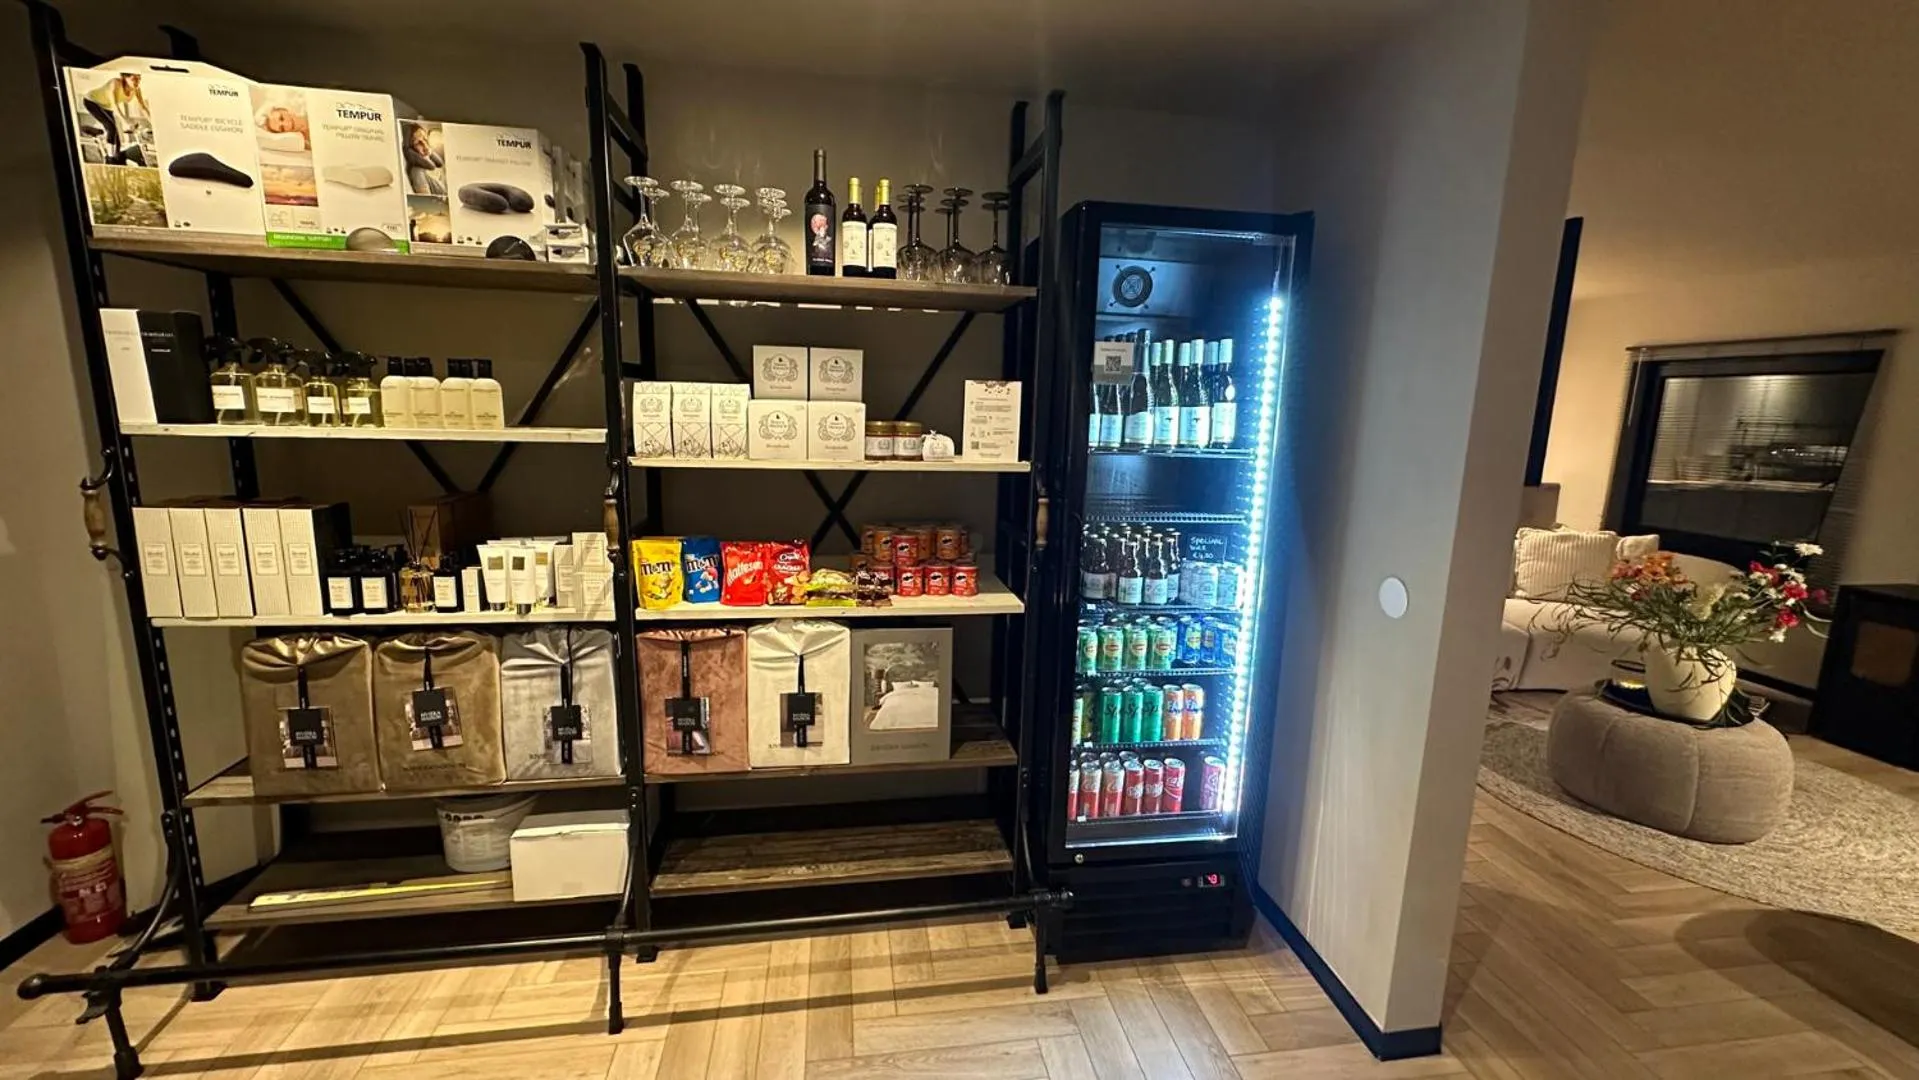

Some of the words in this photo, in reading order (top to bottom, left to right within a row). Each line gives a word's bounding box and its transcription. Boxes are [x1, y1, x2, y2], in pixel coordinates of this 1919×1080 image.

[208, 88, 239, 97] TEMPUR
[336, 108, 383, 122] TEMPUR
[497, 139, 532, 149] TEMPUR
